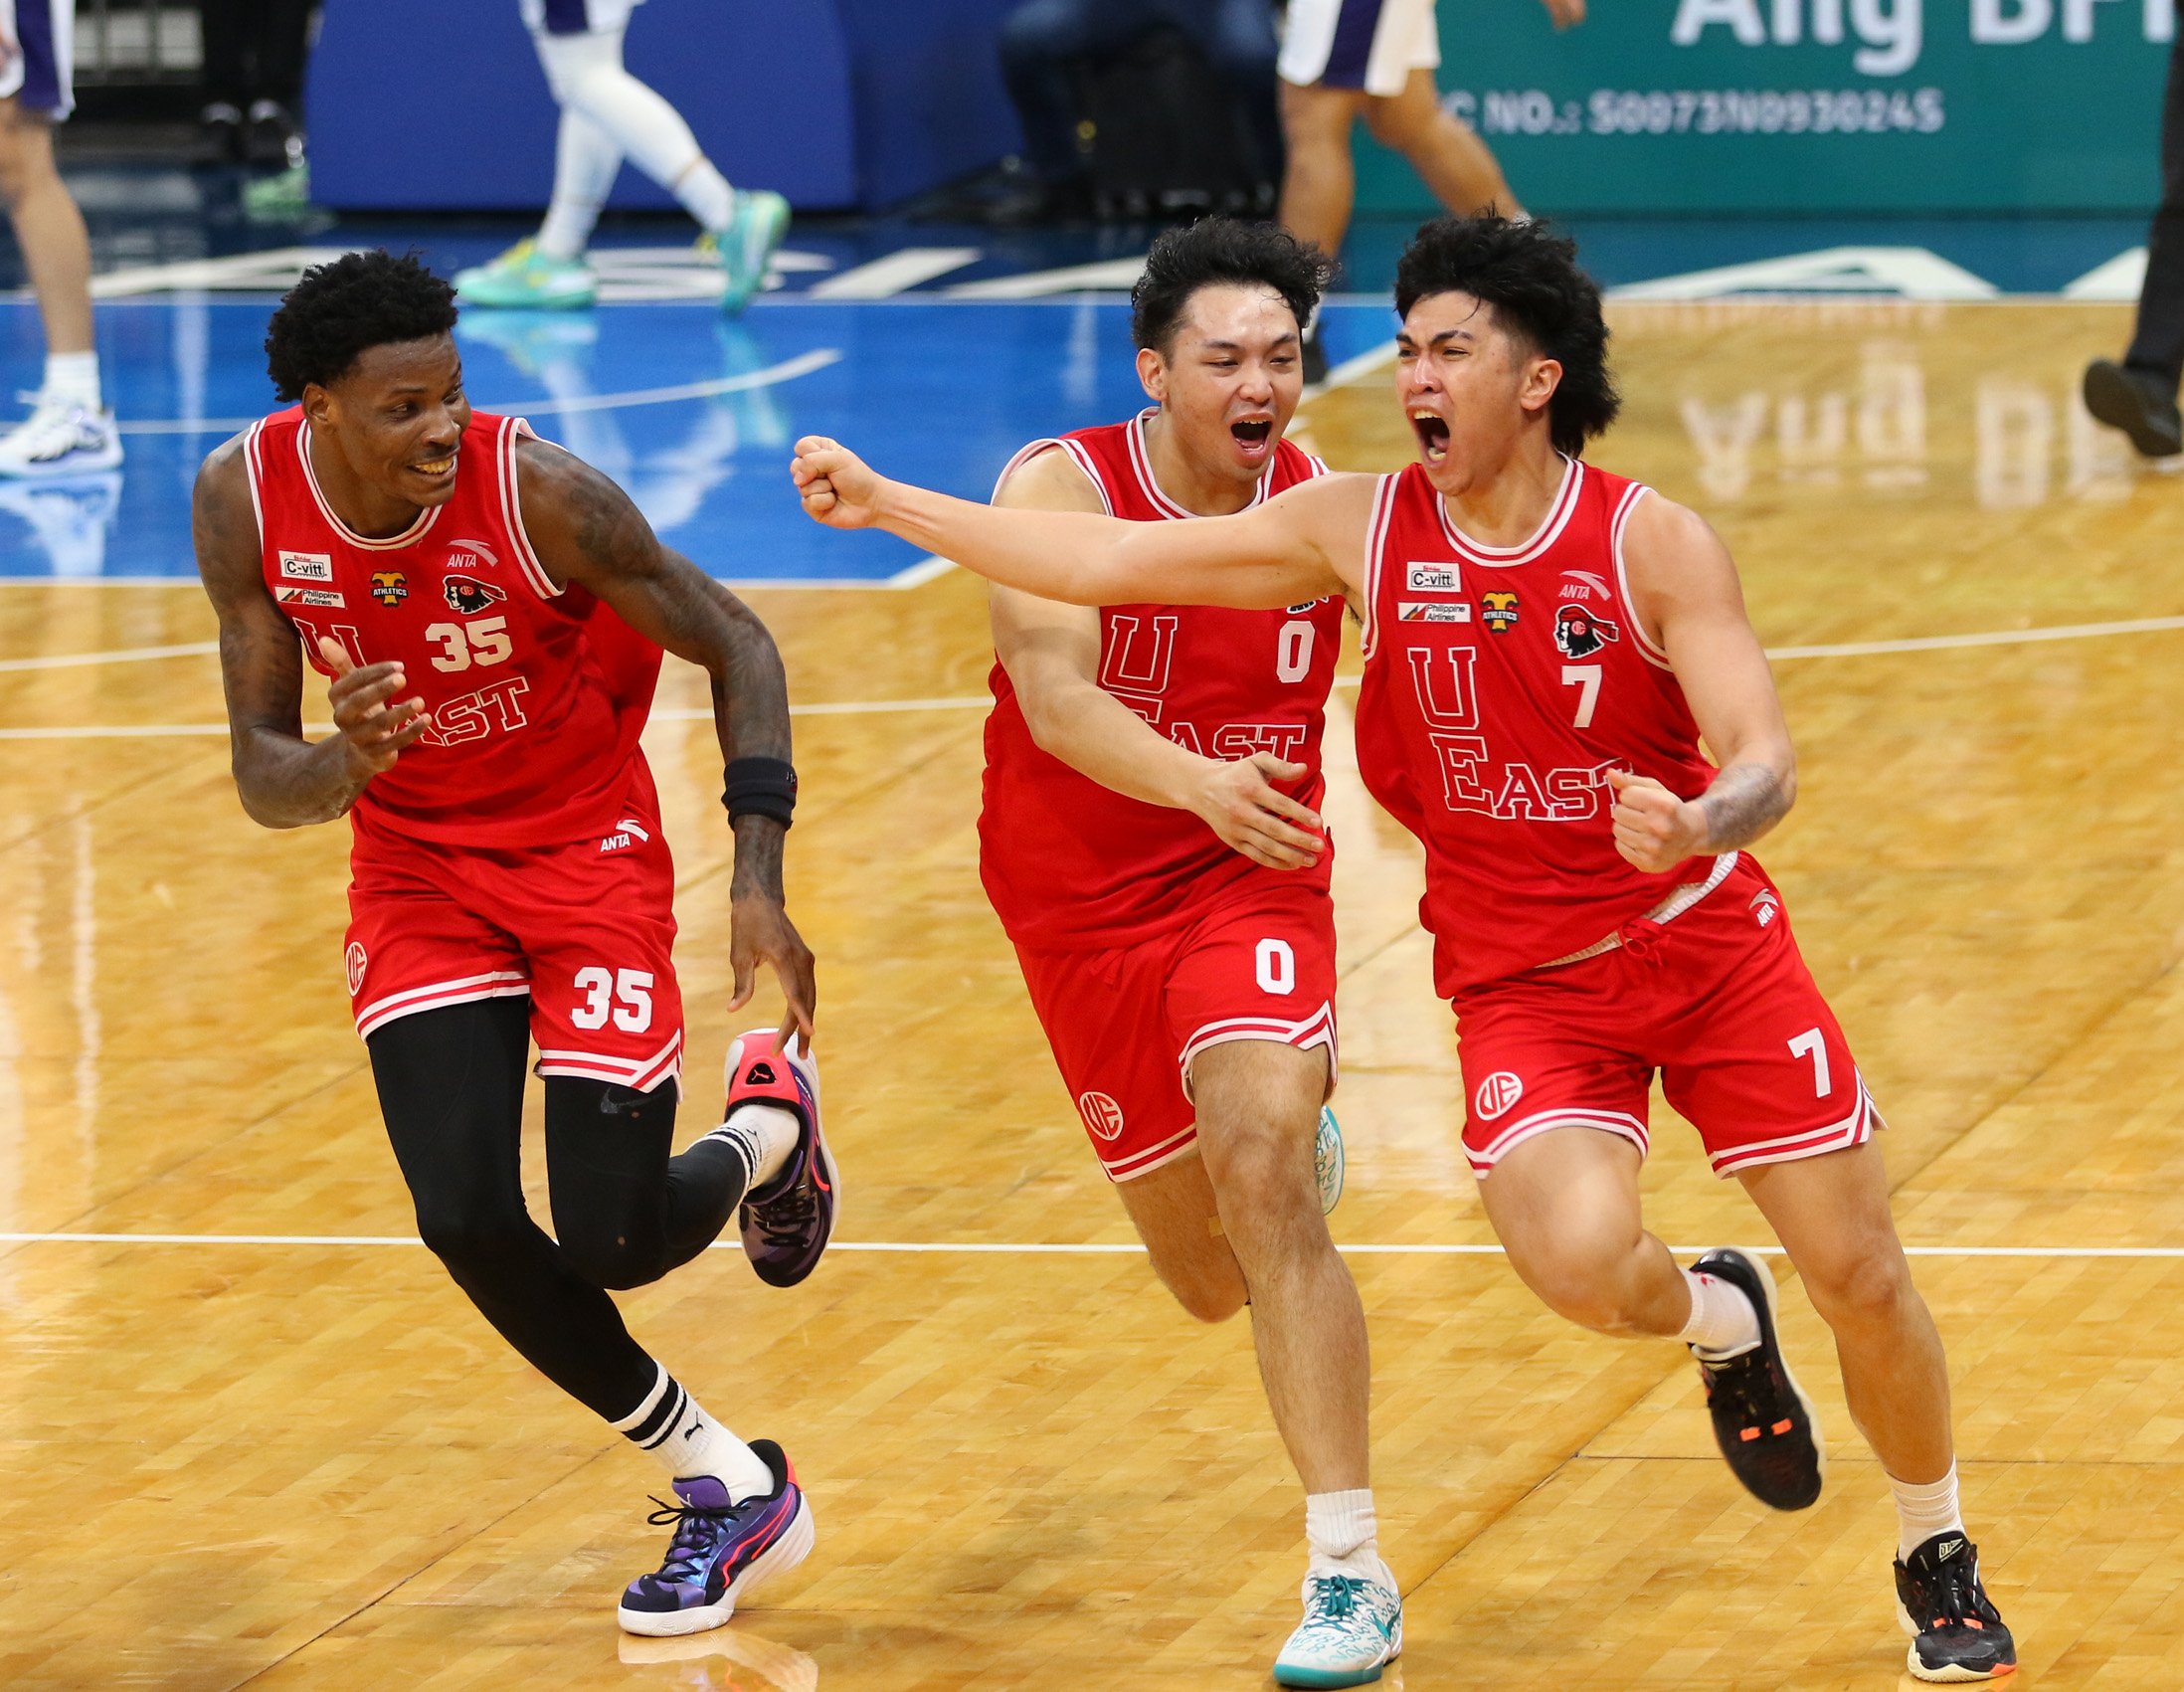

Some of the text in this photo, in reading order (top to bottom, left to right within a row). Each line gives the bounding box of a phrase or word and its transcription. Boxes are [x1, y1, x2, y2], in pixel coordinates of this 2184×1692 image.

[286, 561, 322, 576] C-vitt
[447, 554, 477, 568] ANTA
[1413, 572, 1451, 586] C-vitt
[302, 589, 339, 600] Philippine
[373, 587, 408, 598] ATHLETICS
[1558, 584, 1591, 600] ANTA
[304, 597, 332, 606] Airlines
[1427, 604, 1466, 614] Philippine
[1426, 613, 1456, 622] Airlines
[1483, 610, 1518, 622] ATHLETICS
[425, 616, 513, 673] 35
[1276, 620, 1316, 683] 0
[1101, 615, 1179, 694] U
[1407, 647, 1480, 730] U
[1561, 664, 1602, 728] 7
[600, 833, 631, 852] ANTA
[1756, 903, 1775, 927] ANTA
[1255, 938, 1296, 995] 0
[571, 966, 654, 1034] 35
[1787, 1027, 1832, 1098] 7
